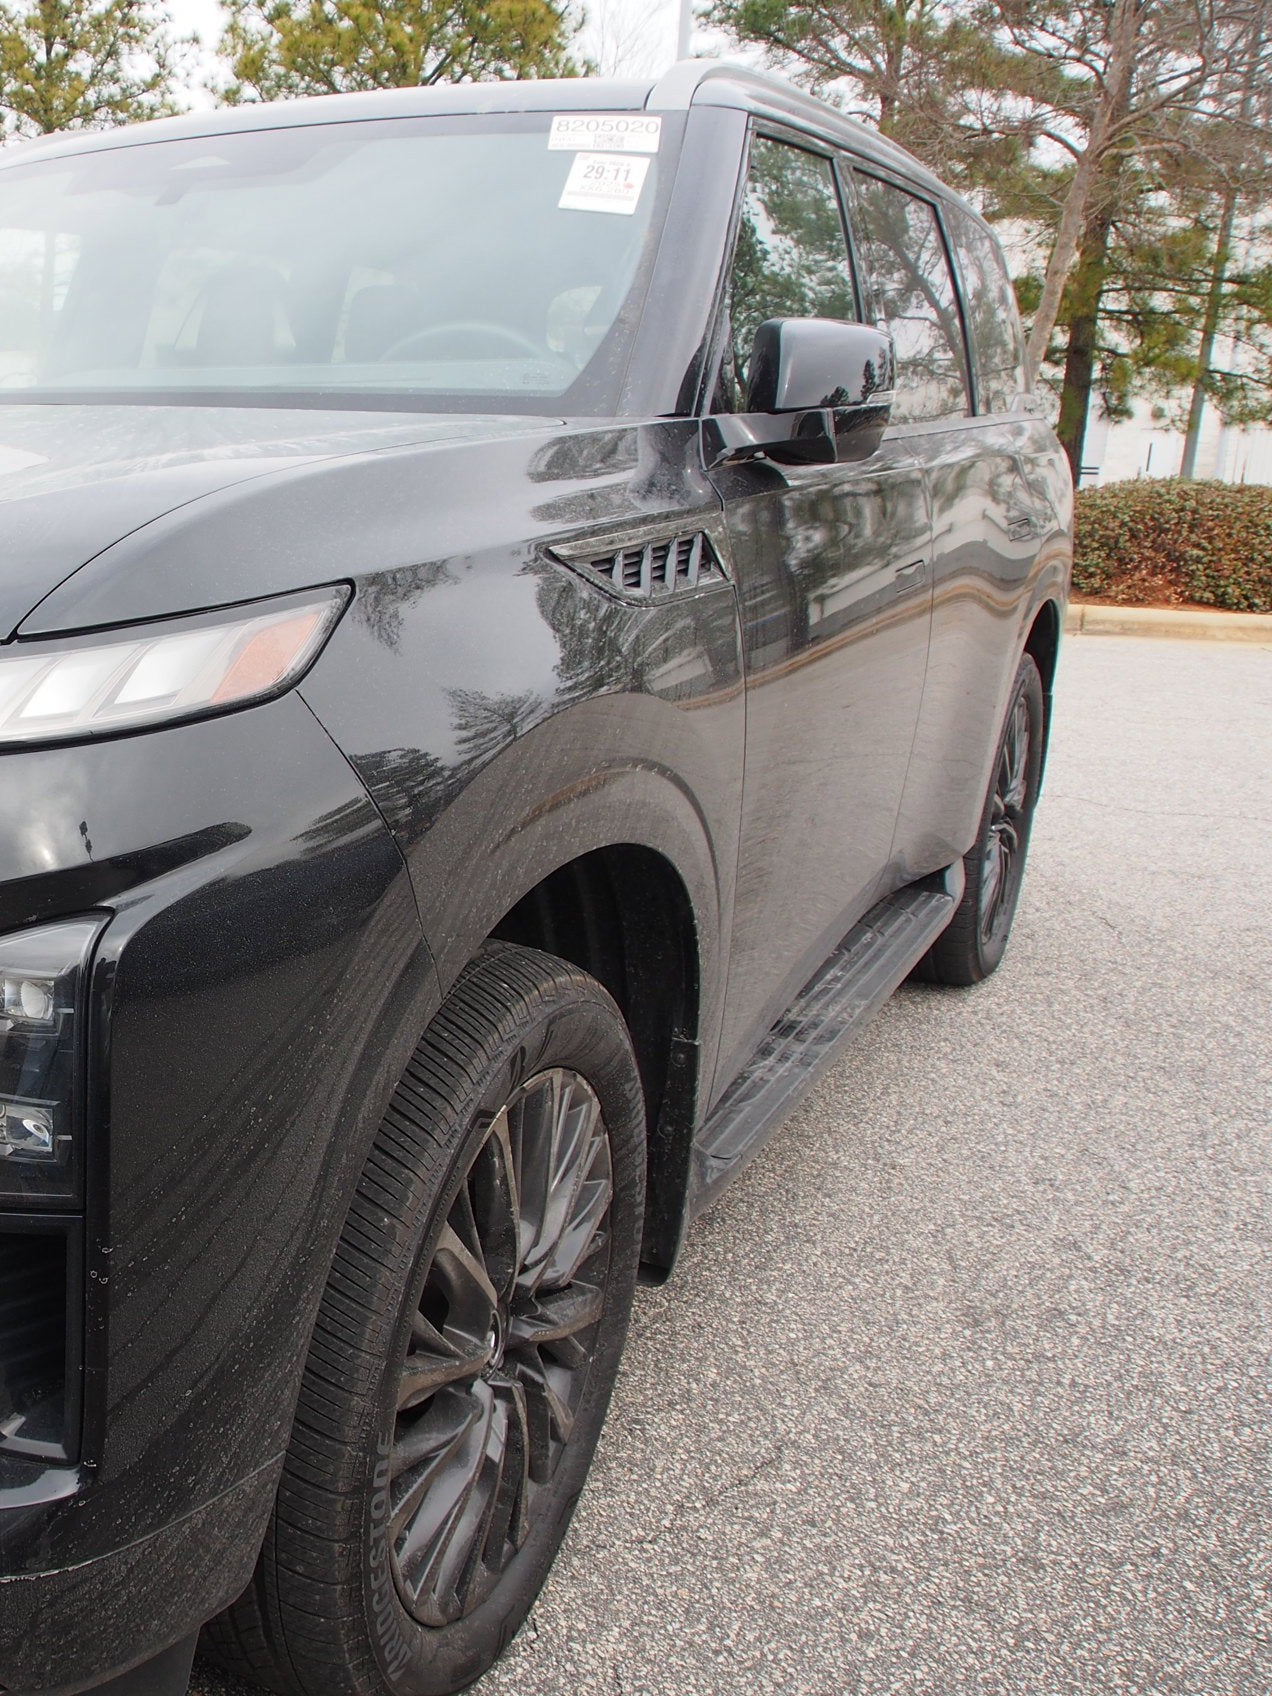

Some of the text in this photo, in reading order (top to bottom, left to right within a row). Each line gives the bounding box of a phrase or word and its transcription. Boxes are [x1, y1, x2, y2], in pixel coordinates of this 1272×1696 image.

[556, 119, 659, 134] 8205020
[582, 164, 632, 182] 29:11
[369, 1431, 412, 1681] BRIDGESTONE
